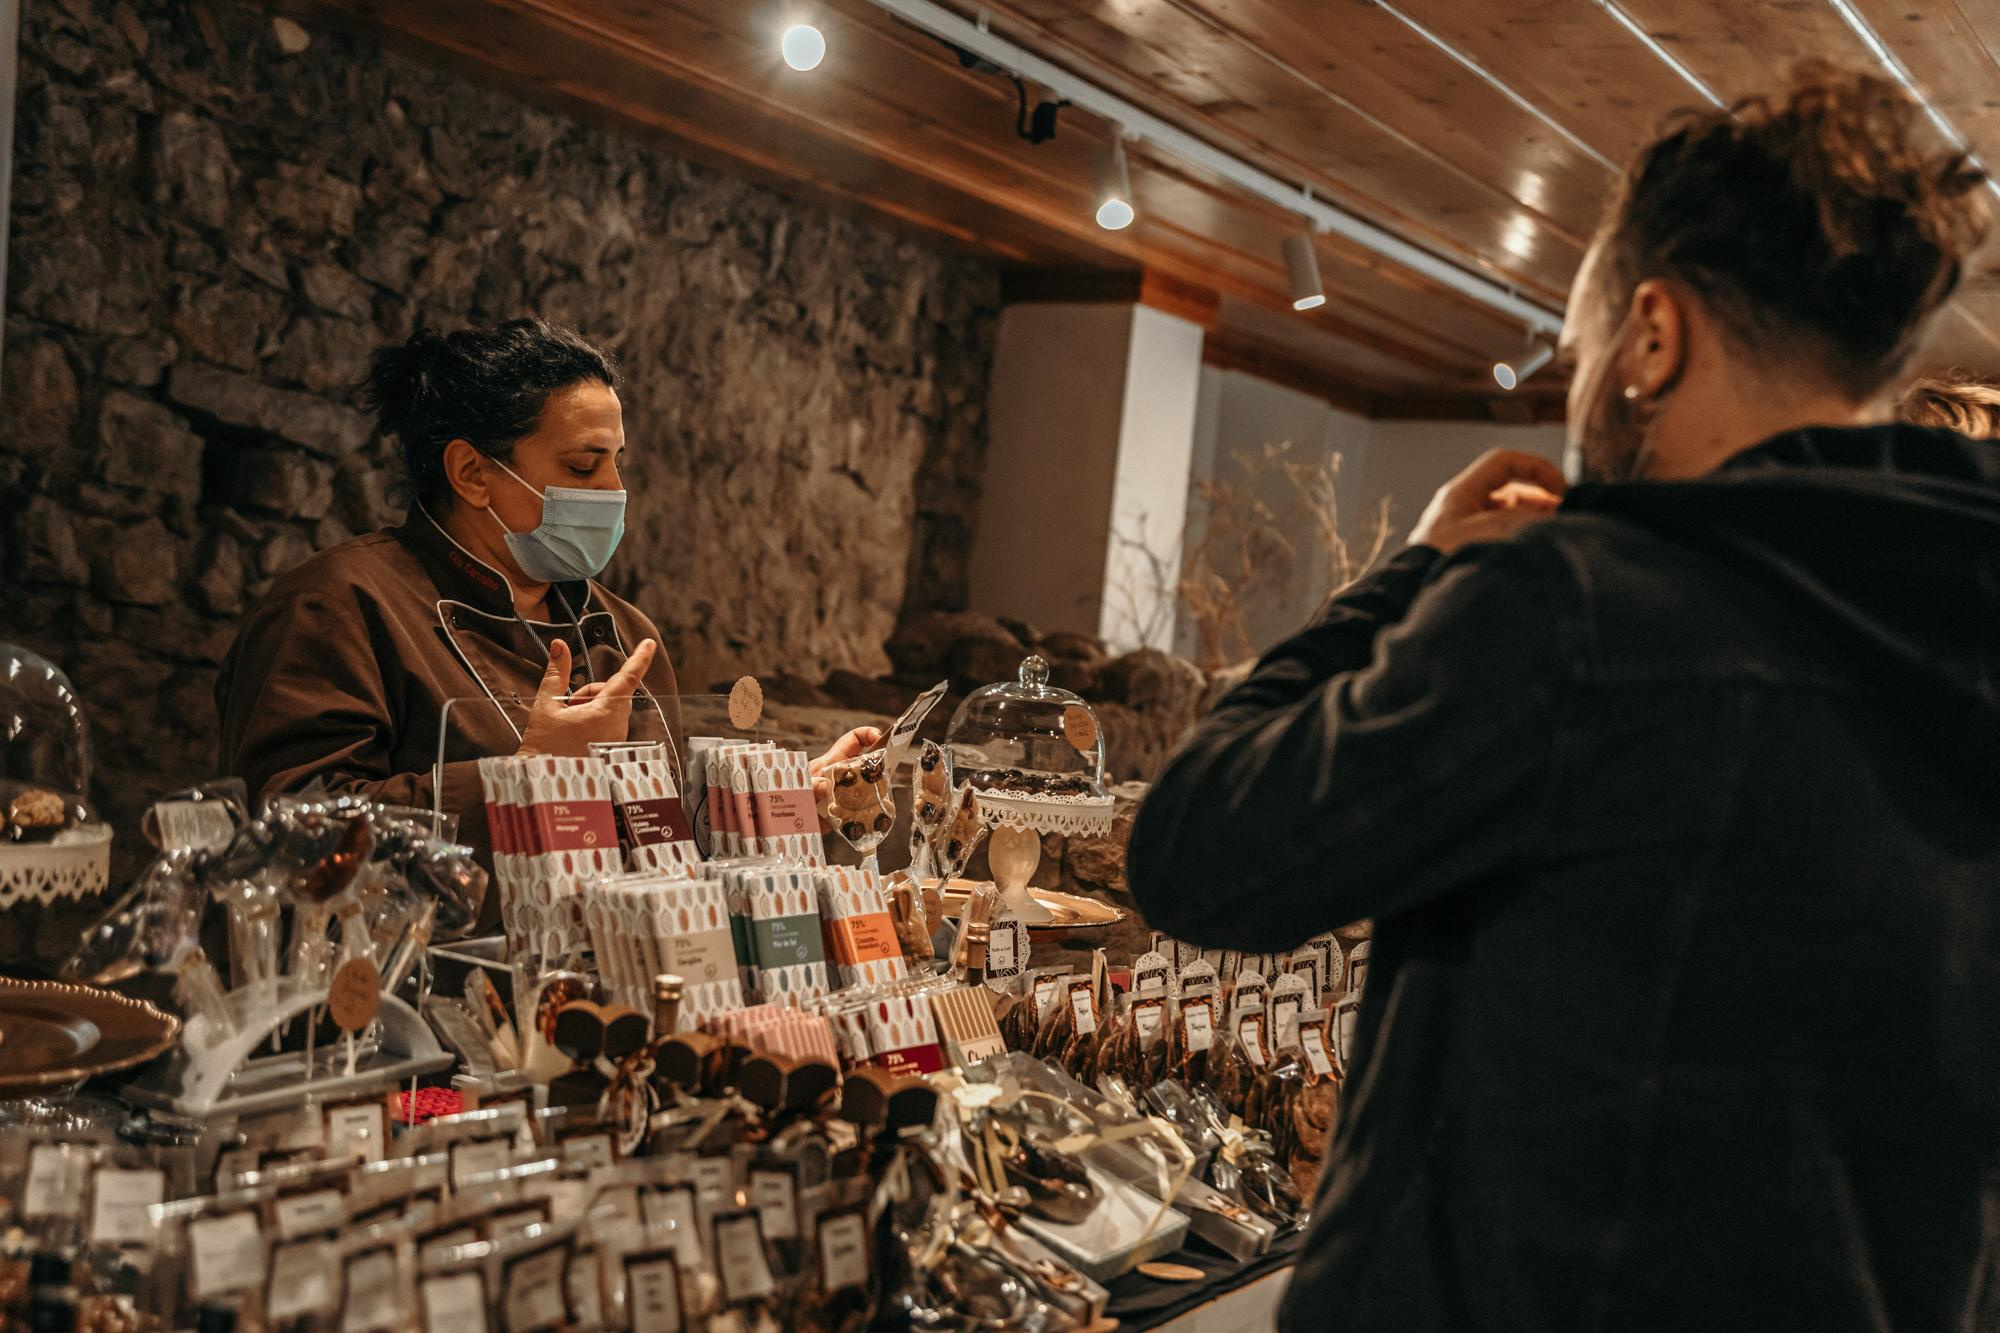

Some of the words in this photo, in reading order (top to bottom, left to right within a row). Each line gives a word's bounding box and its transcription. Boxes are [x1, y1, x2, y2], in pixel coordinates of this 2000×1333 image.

[770, 794, 784, 803] 75%
[553, 805, 570, 815] 75%
[627, 804, 644, 815] 75%
[851, 920, 866, 928] 75%
[887, 1053, 904, 1065] 75%
